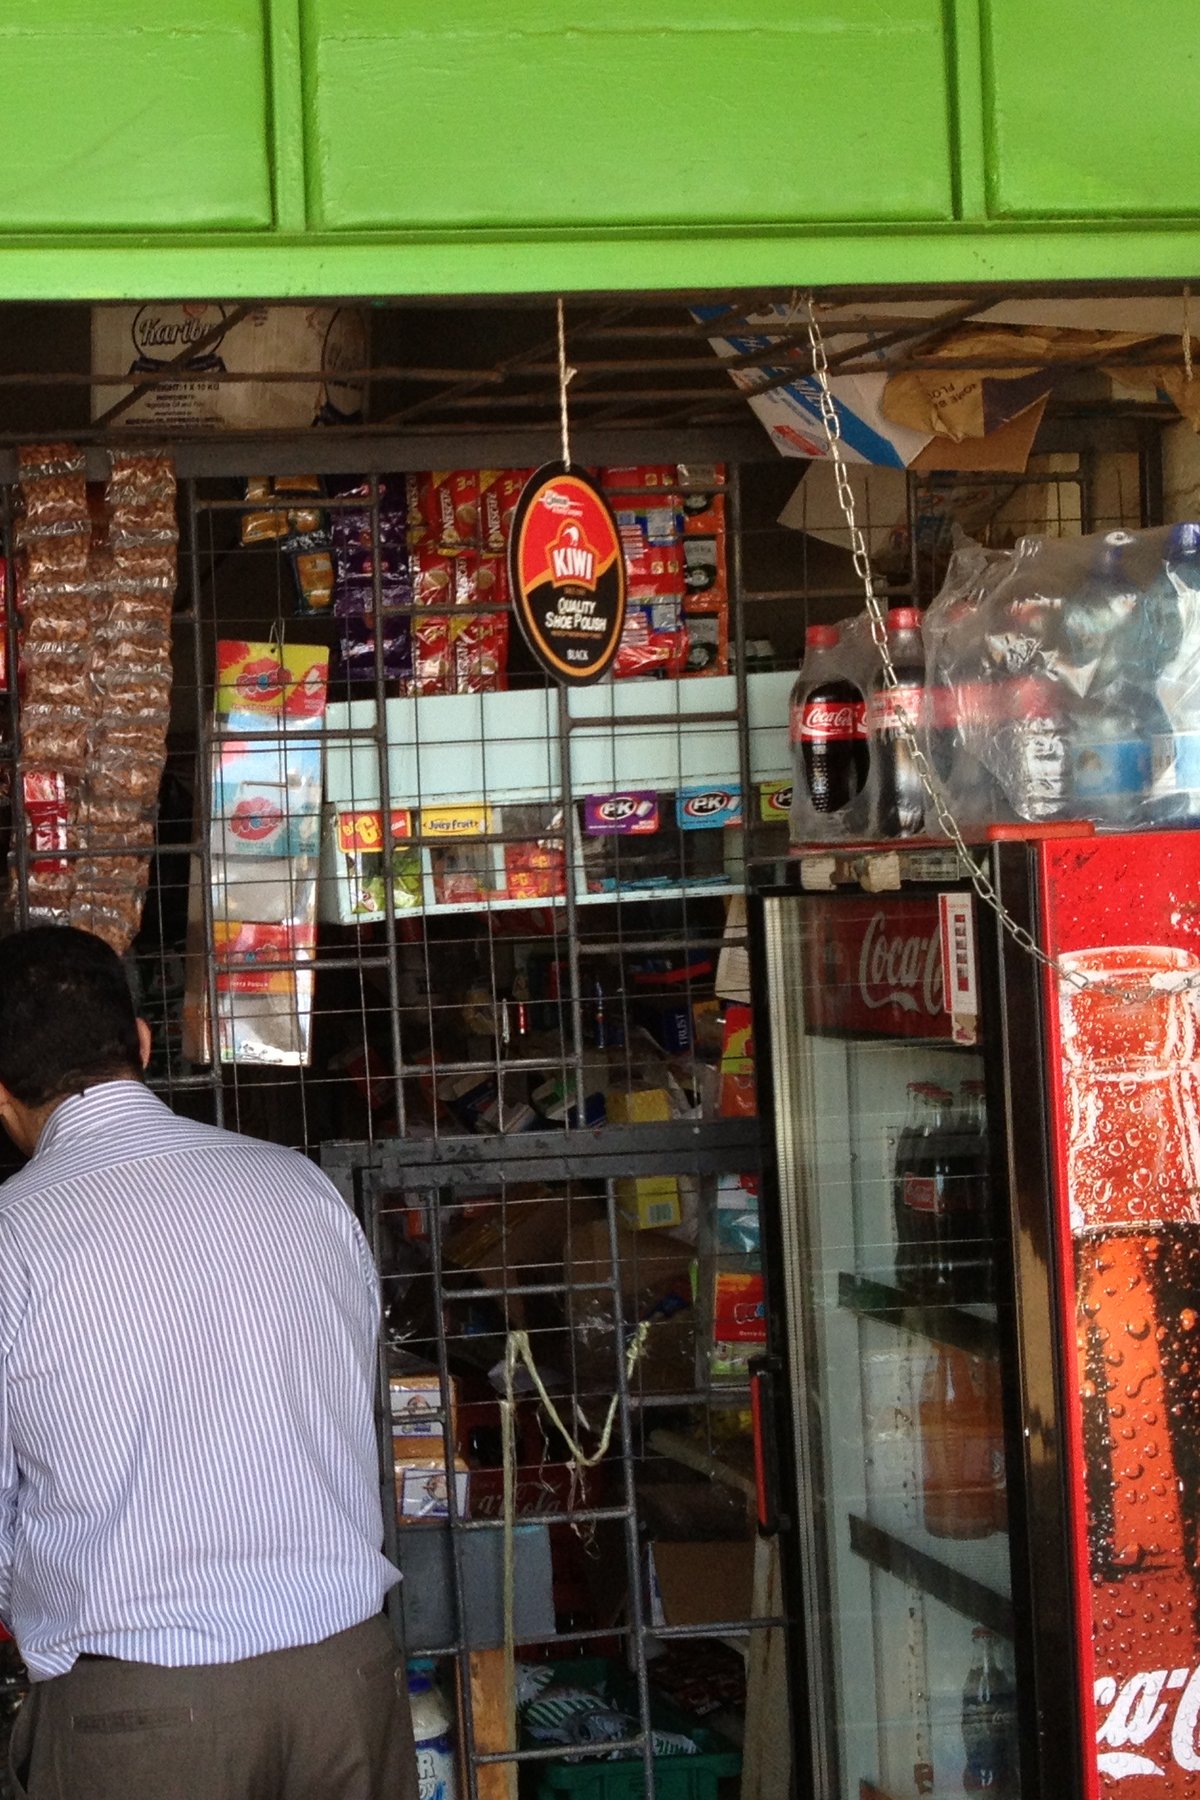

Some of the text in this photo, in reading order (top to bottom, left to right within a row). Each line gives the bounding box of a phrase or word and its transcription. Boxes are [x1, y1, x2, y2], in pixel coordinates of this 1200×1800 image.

[552, 548, 594, 580] KIWI
[557, 596, 596, 614] QUALITY
[545, 612, 608, 632] SHOE POLISH
[566, 648, 589, 661] BLACK
[427, 818, 474, 831] Juicy Fruit
